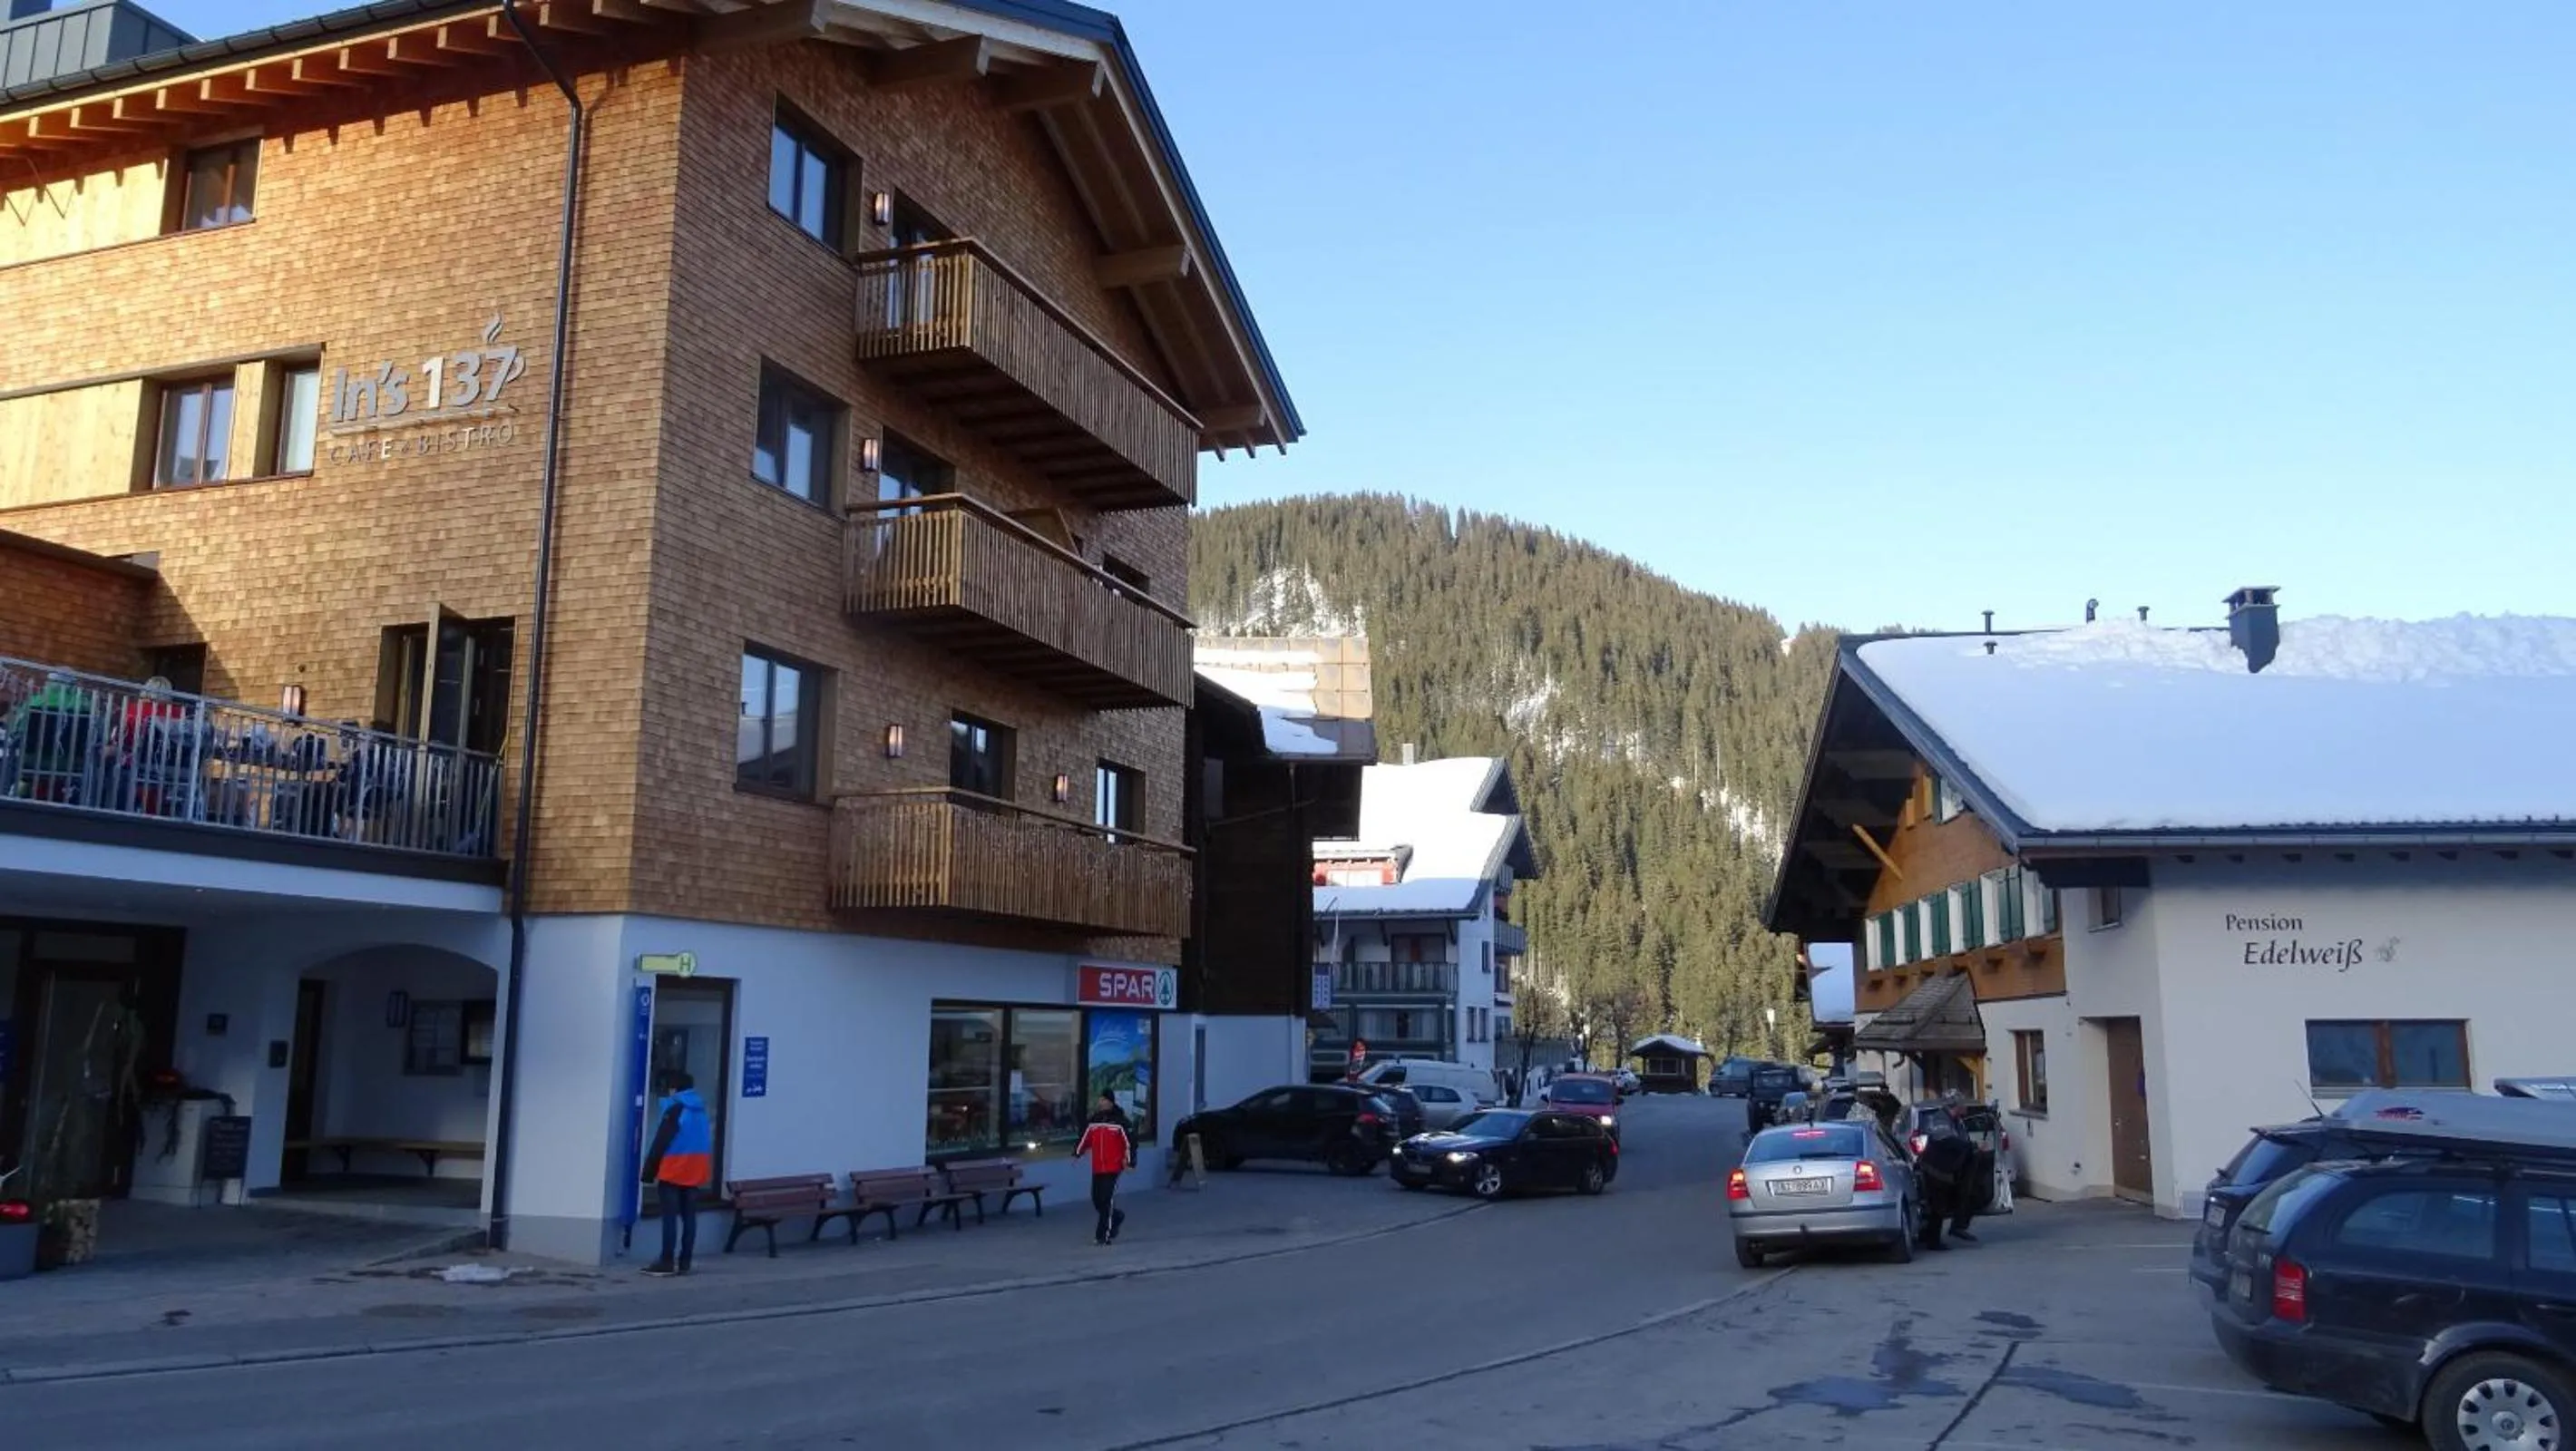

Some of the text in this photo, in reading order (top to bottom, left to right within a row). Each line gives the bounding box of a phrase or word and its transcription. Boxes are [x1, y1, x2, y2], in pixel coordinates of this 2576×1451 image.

[333, 346, 519, 422] In's 137
[417, 424, 514, 455] BISTRO
[2225, 913, 2303, 930] Pension
[2243, 939, 2364, 972] Edelweiß
[1098, 972, 1155, 998] SPAR
